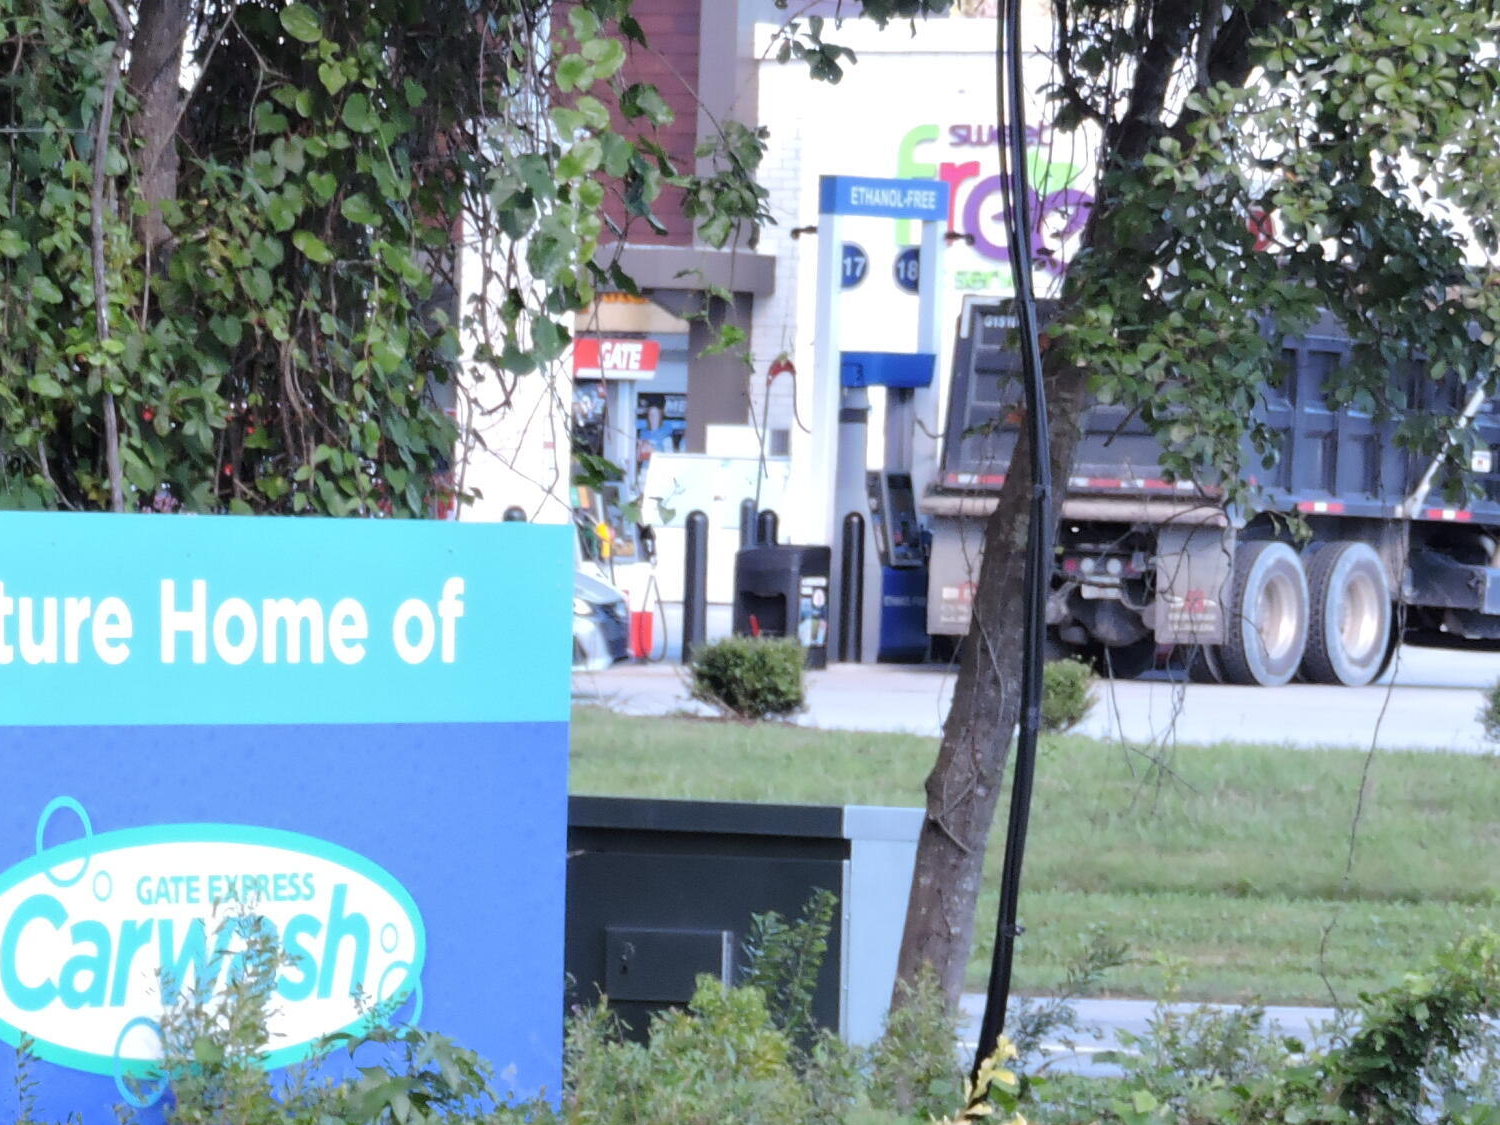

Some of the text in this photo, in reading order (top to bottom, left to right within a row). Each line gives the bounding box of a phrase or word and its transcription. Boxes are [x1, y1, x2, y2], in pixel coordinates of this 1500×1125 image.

[851, 186, 936, 209] ETHANOL-FREE
[843, 256, 865, 277] 17
[898, 258, 918, 279] 18
[600, 342, 643, 370] GATE
[160, 578, 369, 666] Home
[392, 576, 466, 665] of
[136, 872, 316, 905] GATE EXPRESS
[0, 883, 371, 1012] Carwash
